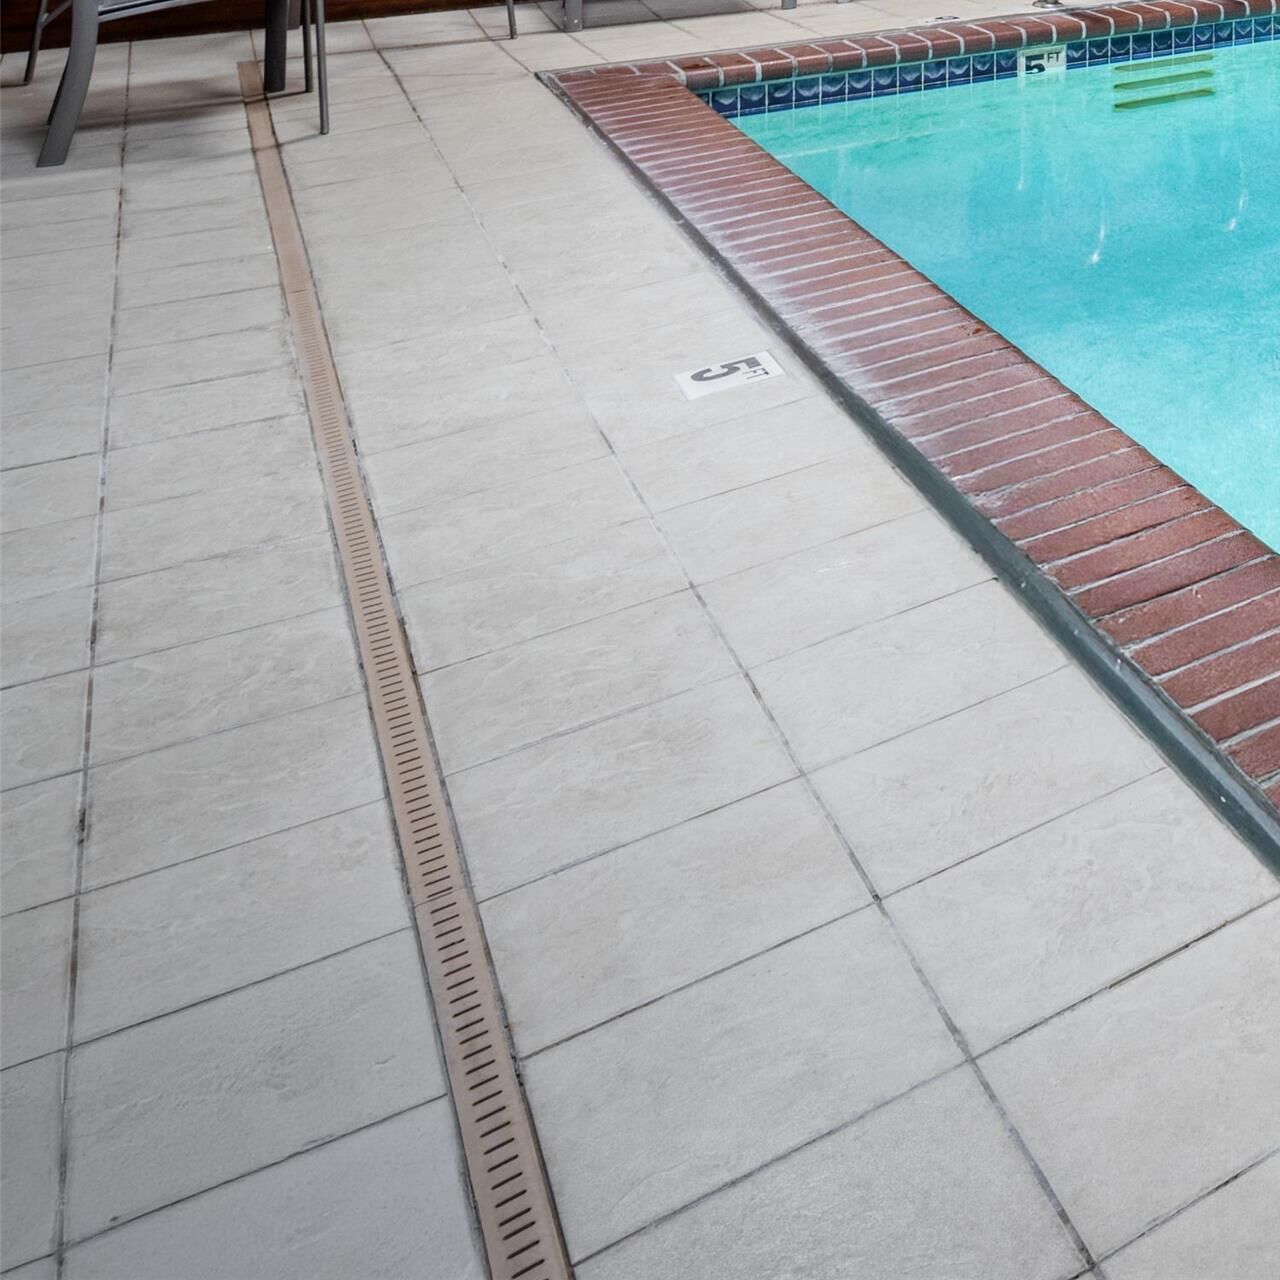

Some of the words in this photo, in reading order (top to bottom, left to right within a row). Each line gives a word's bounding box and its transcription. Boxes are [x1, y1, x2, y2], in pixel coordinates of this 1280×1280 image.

[1025, 53, 1046, 75] 5
[1047, 51, 1061, 63] FT
[690, 356, 762, 382] 5
